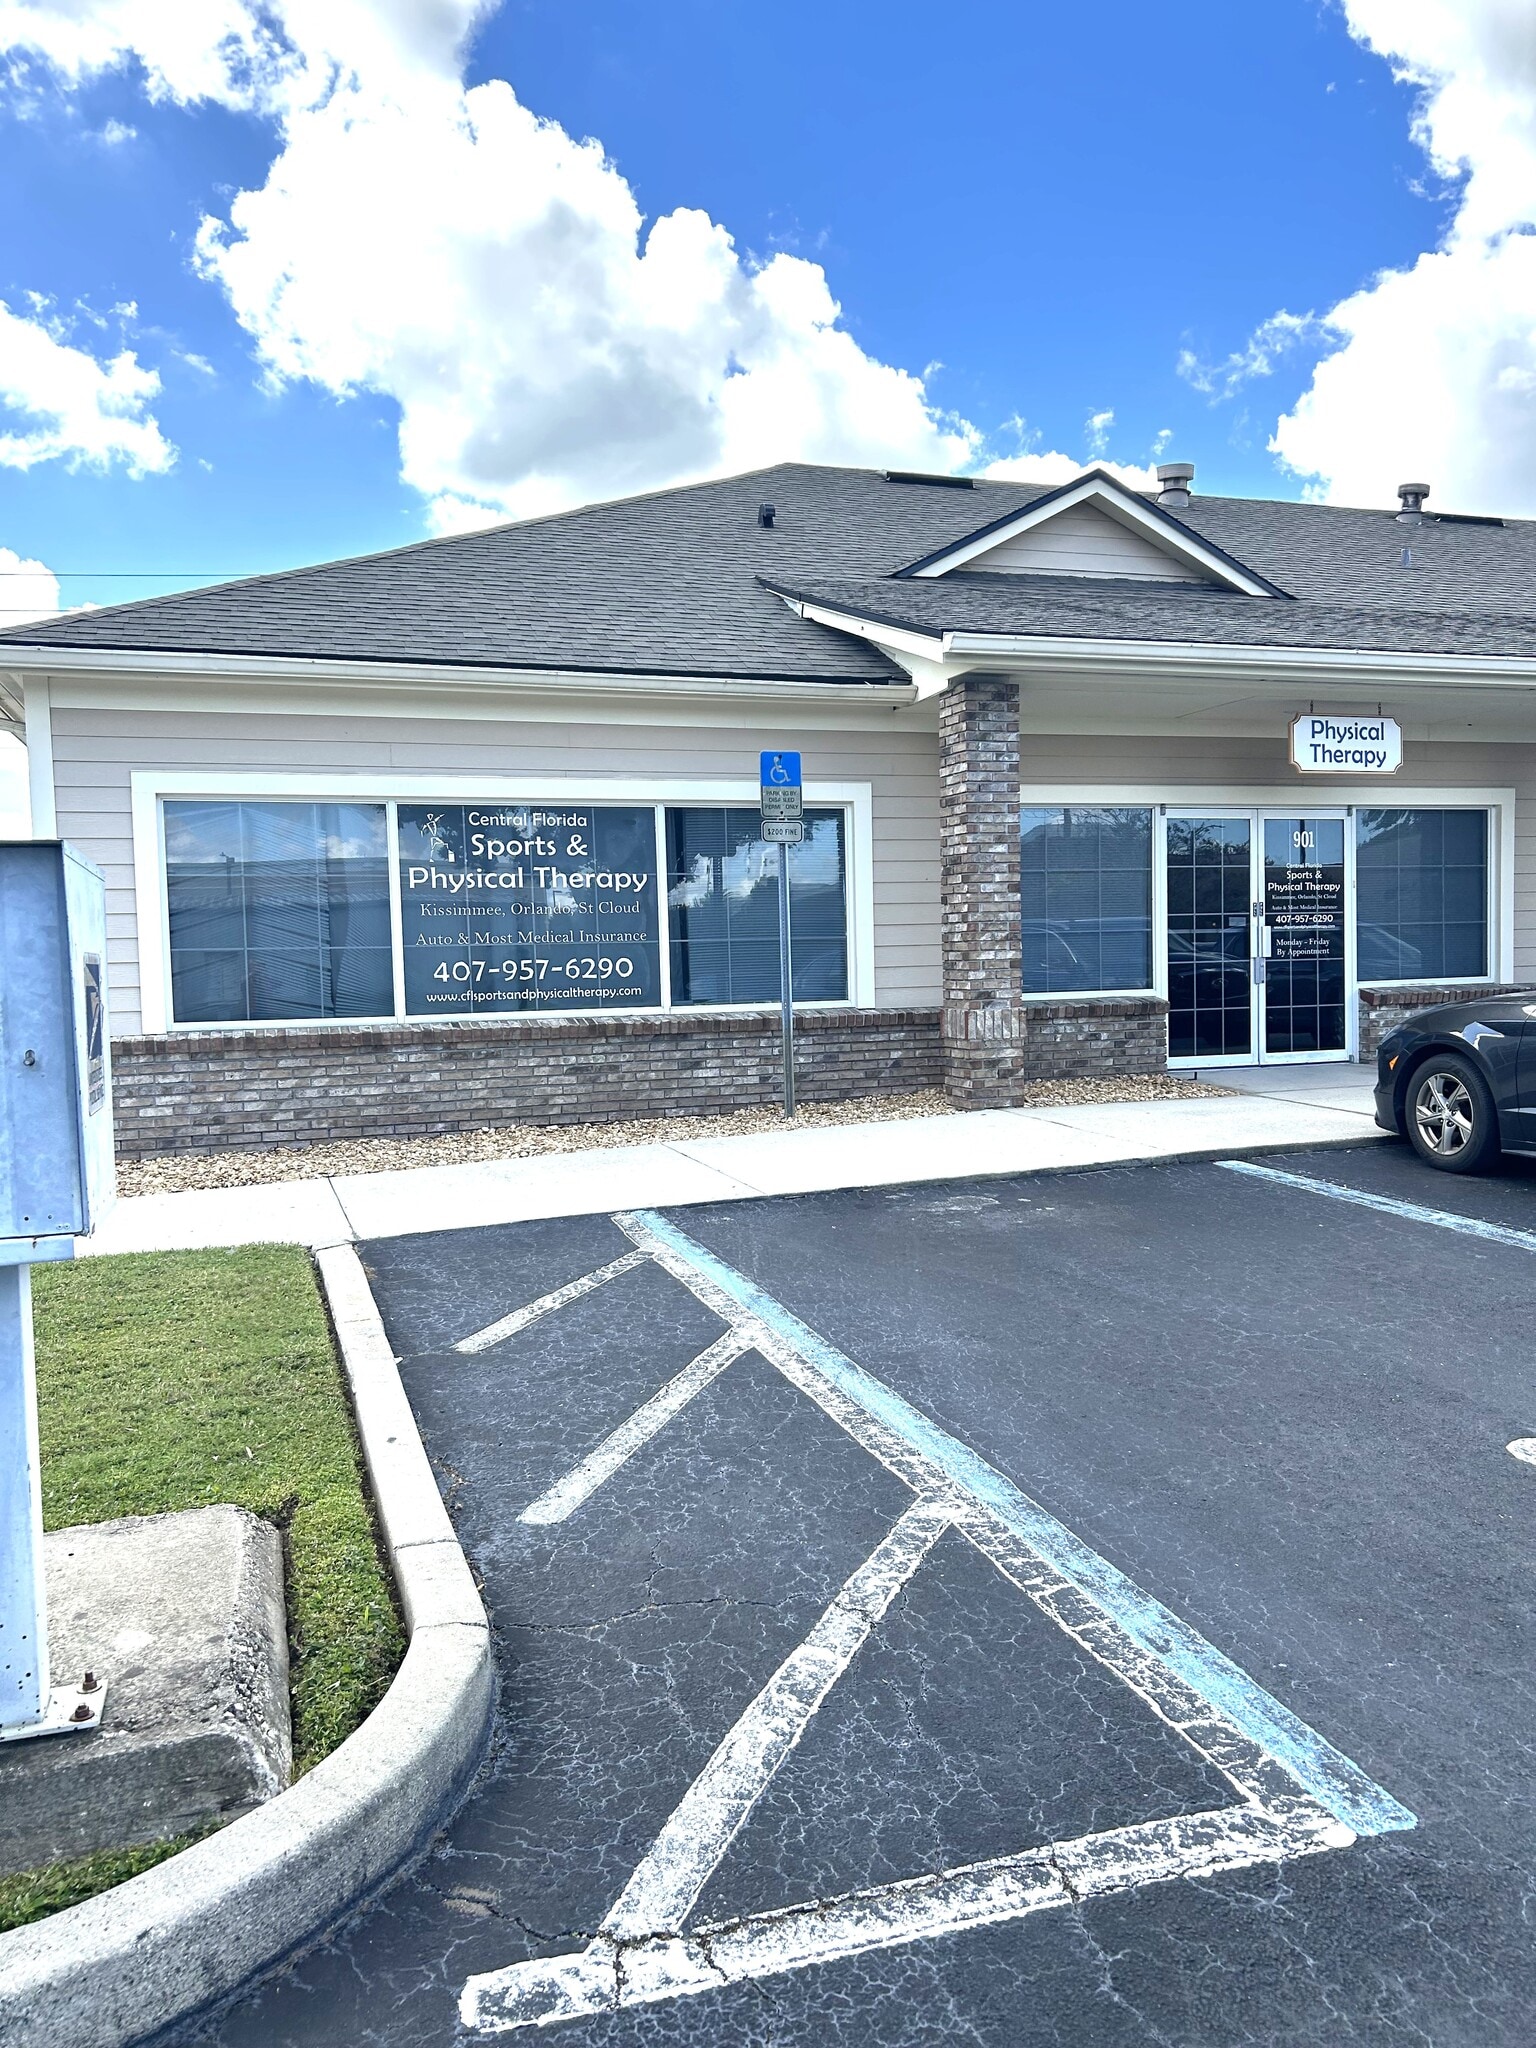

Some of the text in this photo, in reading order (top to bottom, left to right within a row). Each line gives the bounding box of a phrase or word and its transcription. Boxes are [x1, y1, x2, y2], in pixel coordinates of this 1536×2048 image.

[1311, 720, 1384, 743] Physical
[1310, 744, 1386, 768] Therapy
[468, 812, 587, 827] Central Florida
[471, 834, 588, 860] Sports &
[1294, 831, 1314, 848] 901
[408, 866, 648, 893] Physical Therapy
[1287, 871, 1312, 880] Sports
[1268, 882, 1340, 892] Physical Therapy
[420, 901, 640, 917] Kissimmee, Orlando, St Cloud
[1276, 915, 1333, 923] 407-957-6290
[416, 930, 647, 946] Auto & Most Medical Insurance
[1276, 939, 1302, 947] Monday
[1309, 938, 1330, 947] Friday
[1277, 948, 1329, 957] By Appointment
[434, 958, 634, 982] 407-957-6290
[427, 987, 642, 1002] www.cflsportsandphysicaltherapy.com
